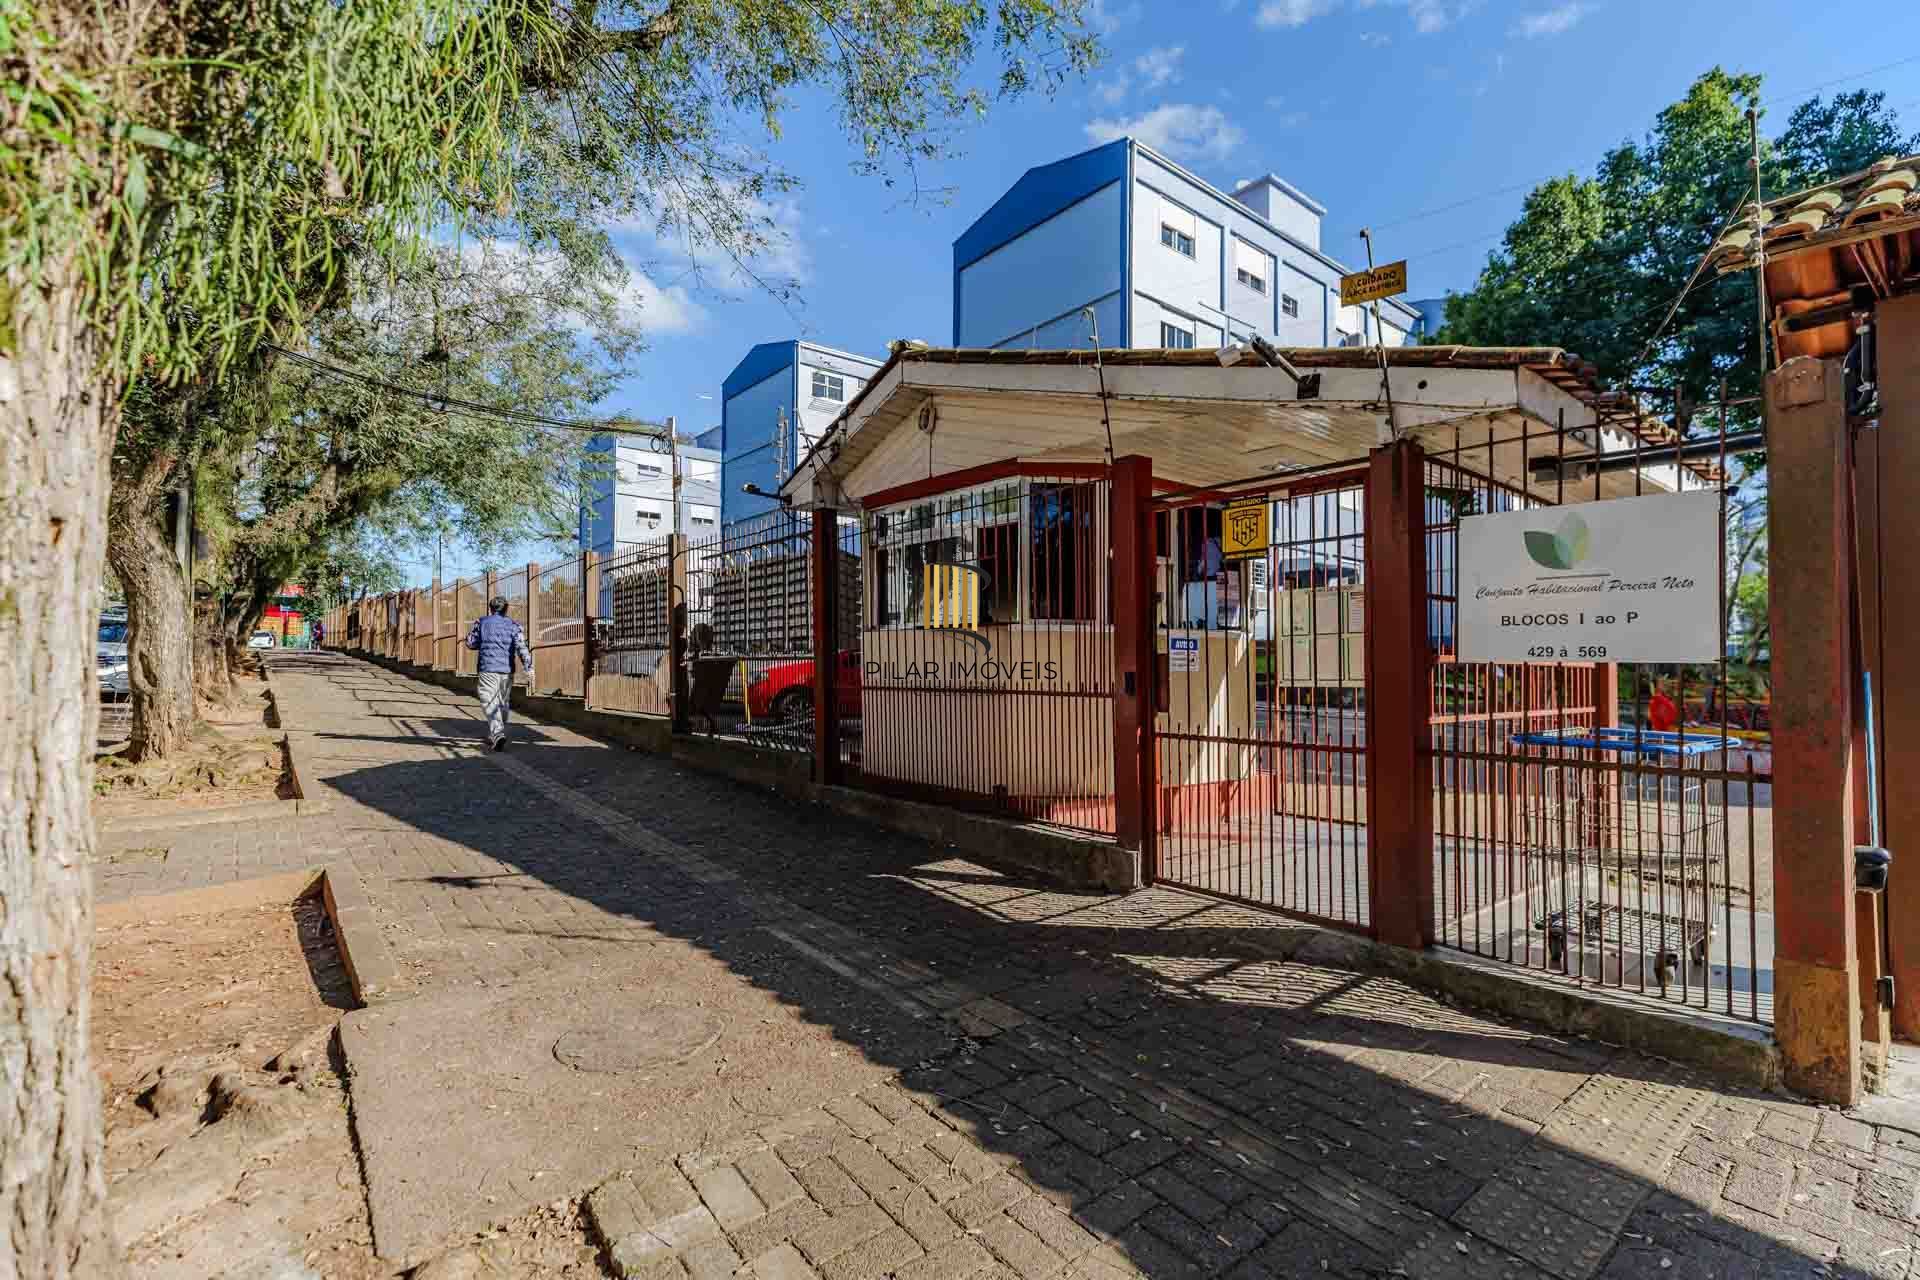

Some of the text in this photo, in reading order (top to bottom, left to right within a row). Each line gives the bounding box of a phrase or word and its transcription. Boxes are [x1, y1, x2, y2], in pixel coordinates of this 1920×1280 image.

[1357, 271, 1396, 286] CUIDADO
[1526, 580, 1604, 595] Habitacional
[1607, 578, 1657, 593] Pereira
[1661, 575, 1695, 590] Neto
[1501, 611, 1639, 626] BLOCOS I ao P
[1175, 640, 1194, 649] AVIO
[1527, 646, 1554, 658] 429
[1578, 646, 1607, 658] 569
